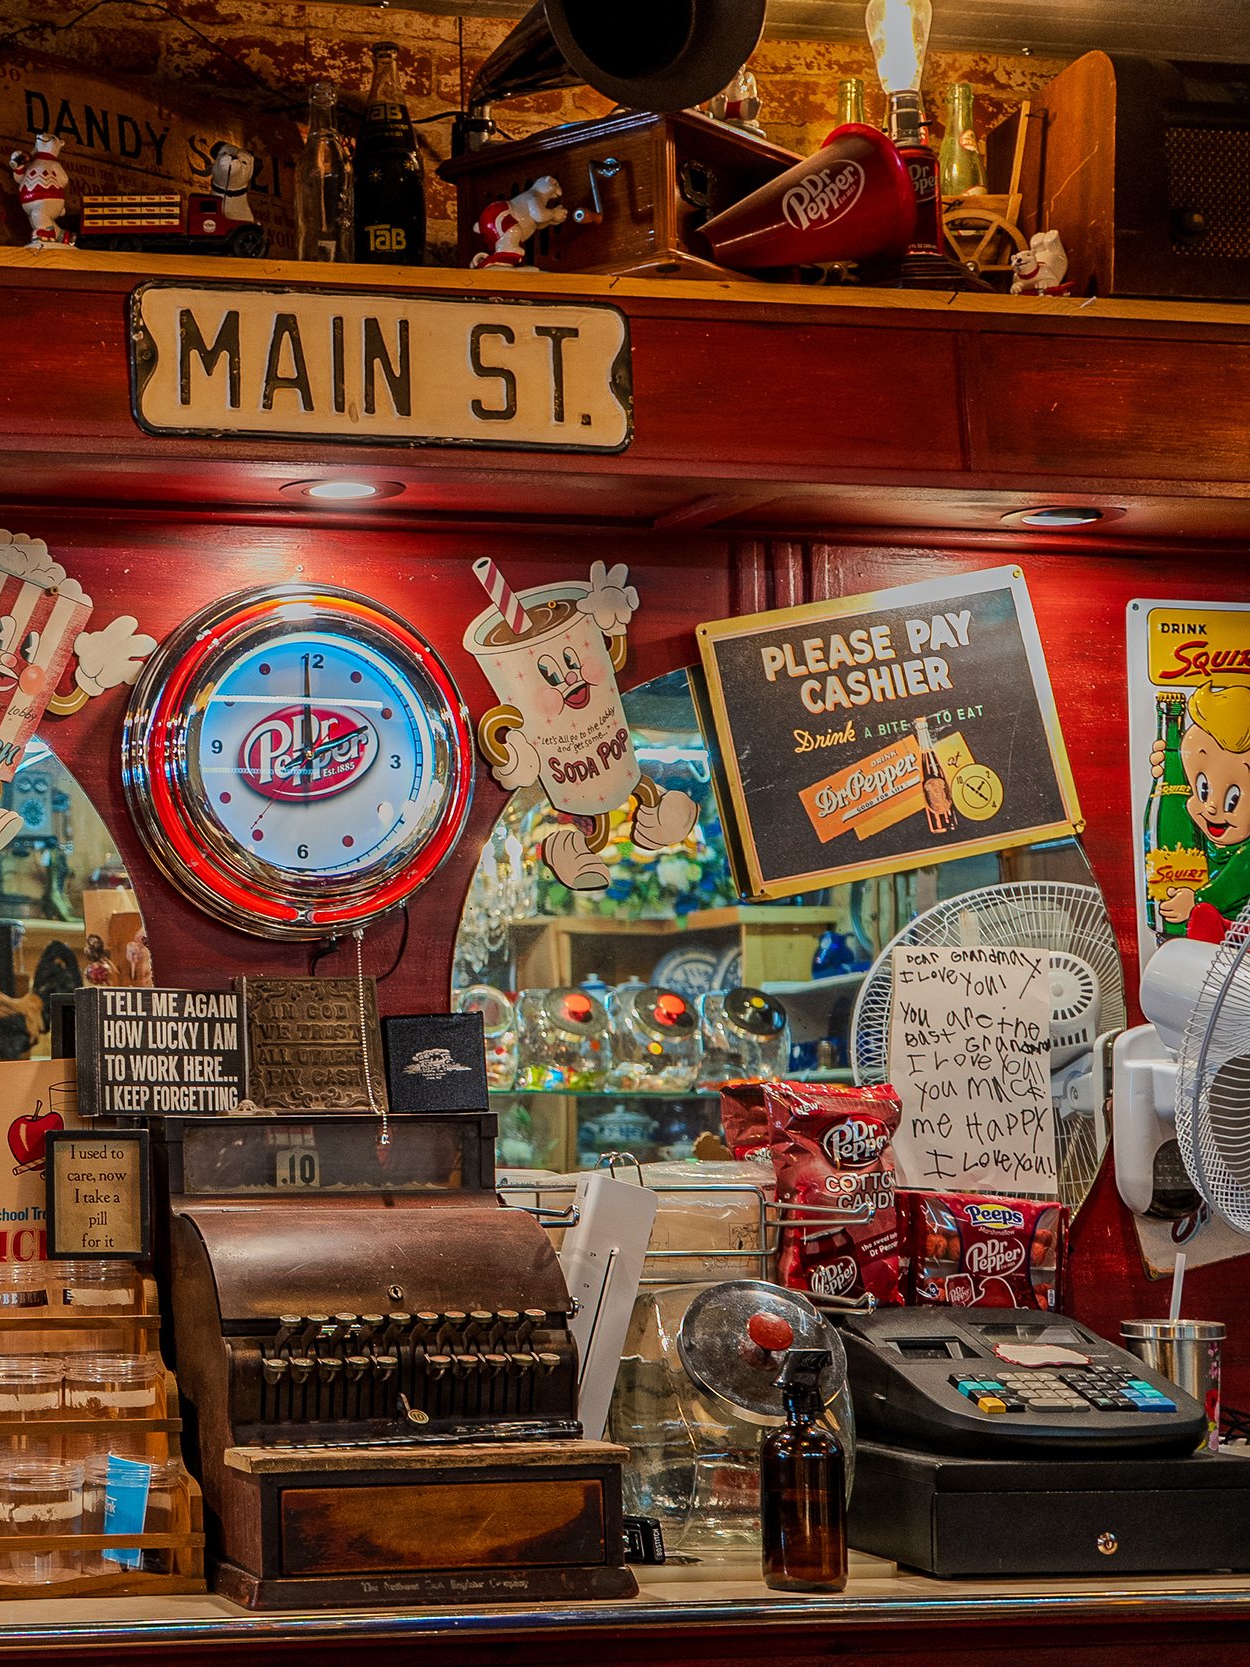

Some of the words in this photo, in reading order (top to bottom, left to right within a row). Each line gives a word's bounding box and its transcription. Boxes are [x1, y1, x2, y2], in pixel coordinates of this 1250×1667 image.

[24, 88, 171, 166] DANDY
[800, 168, 833, 197] Dr
[788, 164, 856, 231] Pepper
[179, 308, 412, 418] MAIN
[471, 323, 593, 427] ST.
[1160, 622, 1208, 635] DRINK
[760, 624, 897, 683] PLEASE
[905, 610, 973, 654] PAY
[301, 653, 325, 670] 12
[800, 656, 955, 714] CASHIER
[291, 714, 341, 752] Dr
[558, 734, 570, 744] all
[570, 735, 579, 746] go
[579, 730, 587, 739] to
[587, 723, 600, 735] the
[793, 720, 857, 754] Drink
[863, 726, 875, 740] A
[878, 718, 910, 737] BITE
[934, 709, 954, 726] TO
[958, 704, 986, 722] EAT
[211, 739, 224, 755] 9
[548, 756, 601, 784] SODA
[596, 728, 629, 770] POP
[557, 745, 572, 753] and
[573, 741, 585, 754] get
[390, 755, 402, 770] 3
[870, 749, 899, 769] DRINK
[946, 749, 963, 770] at
[985, 769, 992, 780] 2
[856, 801, 875, 813] GOOD
[876, 793, 890, 803] FOR
[990, 800, 999, 811] 4
[297, 844, 310, 860] 6
[899, 970, 914, 984] I
[102, 991, 147, 1016] TELL
[151, 993, 179, 1018] ME
[183, 993, 238, 1019] AGAIN
[270, 1002, 296, 1020] IN
[306, 1002, 349, 1020] GOD
[103, 1020, 143, 1049] HOW
[147, 1021, 200, 1050] LUCKY
[203, 1022, 210, 1050] I
[213, 1022, 238, 1050] AM
[257, 1022, 291, 1040] WE
[296, 1022, 362, 1041] TRUST
[257, 1047, 293, 1066] ALL
[295, 1047, 365, 1067] OTHERS
[906, 1053, 927, 1077] I
[104, 1054, 126, 1082] TO
[129, 1055, 180, 1083] WORK
[183, 1056, 239, 1083] HERE...
[264, 1067, 303, 1087] PAY
[310, 1067, 363, 1087] CASH
[104, 1085, 111, 1111] I
[113, 1085, 150, 1112] KEEP
[153, 1086, 239, 1112] FORGETTING
[794, 1101, 820, 1117] NEW
[848, 1119, 878, 1141] Dr
[911, 1112, 953, 1139] me
[70, 1144, 76, 1160] I
[78, 1144, 108, 1160] used
[111, 1148, 124, 1160] to
[923, 1149, 957, 1179] I
[67, 1172, 96, 1183] care,
[99, 1172, 127, 1182] now
[75, 1188, 80, 1204] I
[83, 1189, 111, 1204] take
[113, 1194, 121, 1203] a
[88, 1211, 108, 1229] pill
[964, 1204, 1025, 1226] Peeps
[81, 1233, 102, 1248] for
[105, 1234, 115, 1248] it
[978, 1226, 1017, 1237] Marshmallow
[986, 1239, 1009, 1252] Dr
[971, 1242, 1022, 1274] Pepper
[825, 1259, 845, 1281] Dr
